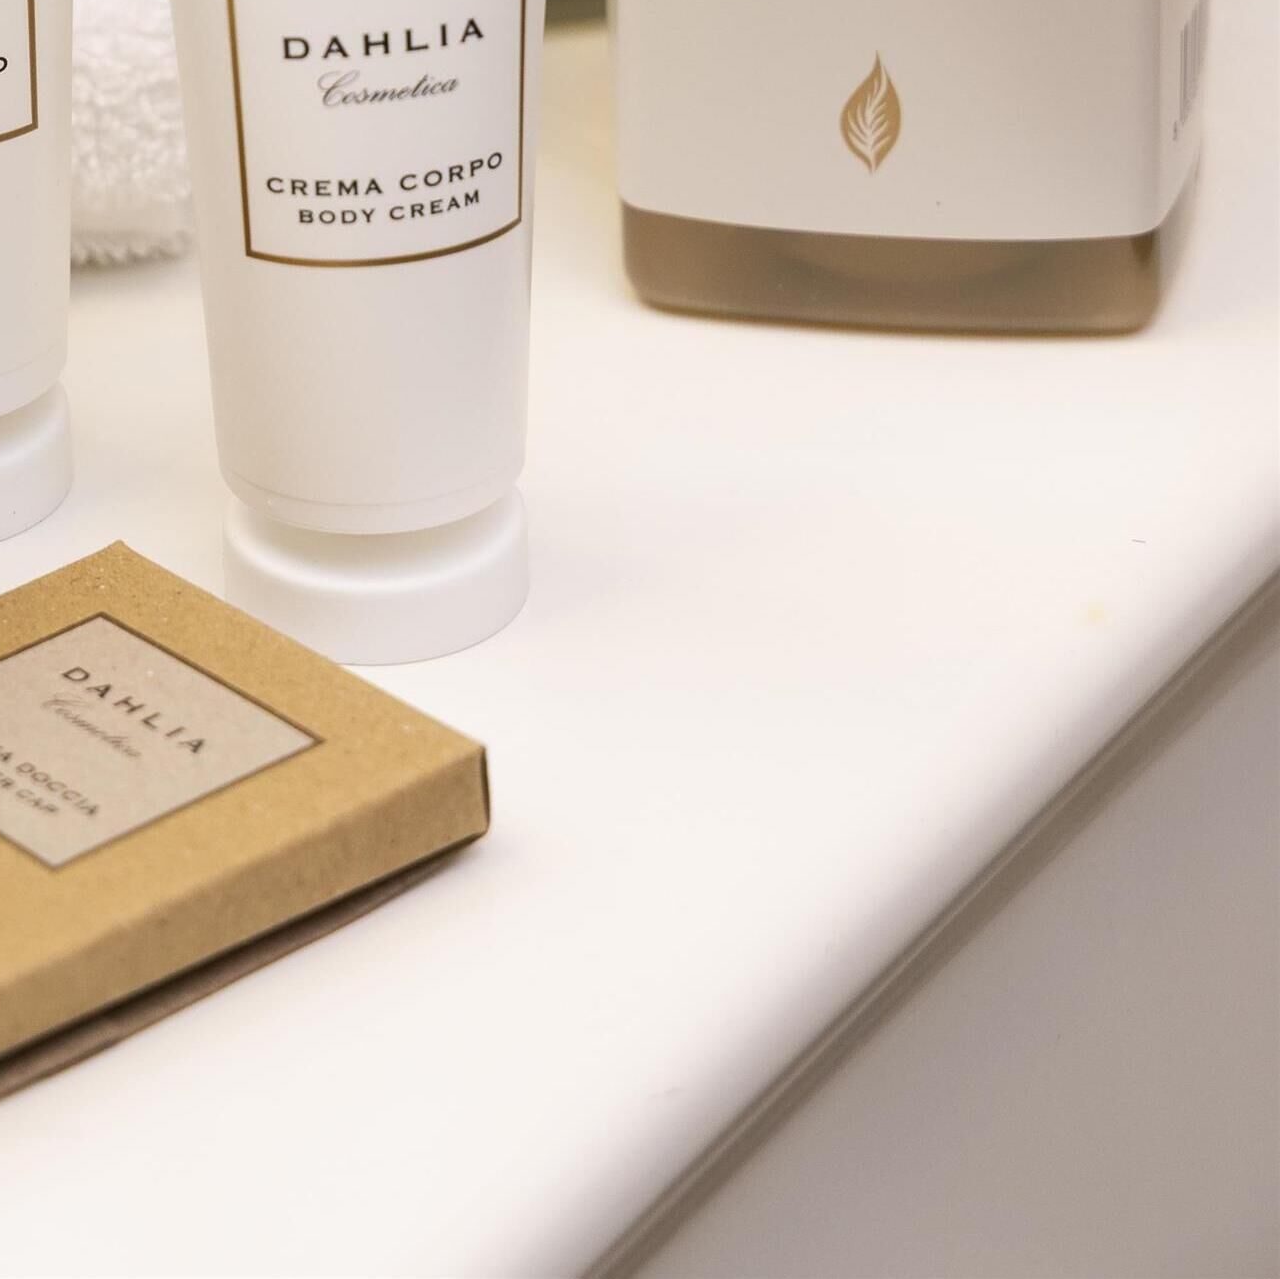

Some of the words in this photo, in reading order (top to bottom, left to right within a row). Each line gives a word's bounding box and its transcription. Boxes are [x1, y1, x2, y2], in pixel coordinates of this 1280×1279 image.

[283, 18, 483, 60] DAHLIA
[317, 70, 459, 107] Cosmetica
[266, 177, 384, 196] CREMA
[400, 152, 502, 191] CORPO
[299, 209, 375, 224] BODY
[389, 190, 480, 220] CREAM
[61, 666, 206, 755] DAHLIA
[16, 762, 99, 818] DOCCIA
